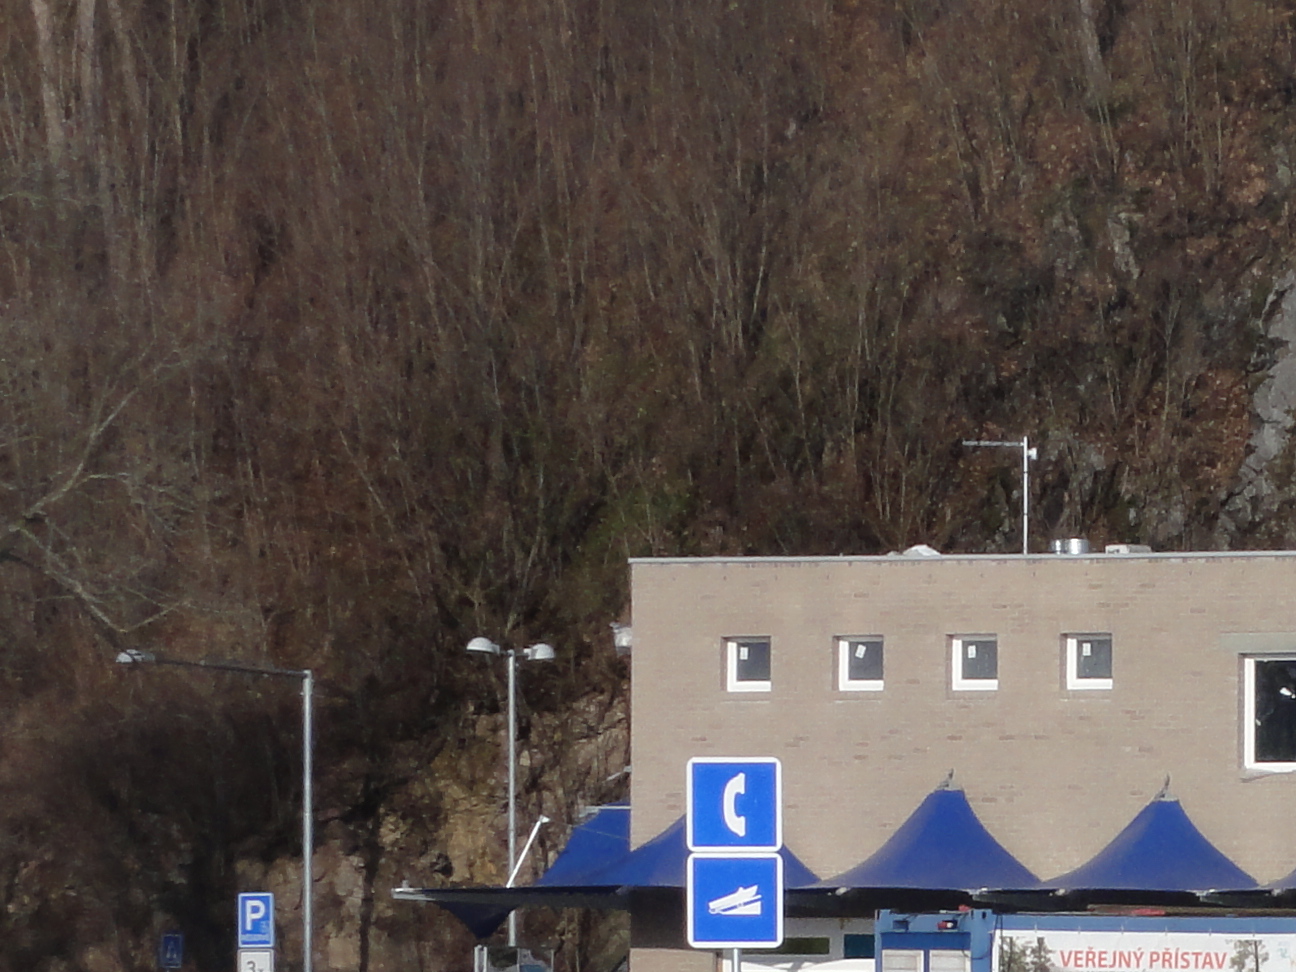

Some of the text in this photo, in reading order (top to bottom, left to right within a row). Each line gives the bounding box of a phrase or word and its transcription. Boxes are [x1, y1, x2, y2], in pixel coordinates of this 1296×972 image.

[246, 899, 265, 931] P
[1059, 947, 1227, 969] VEŘEJNÝ PŘÍSTAV
